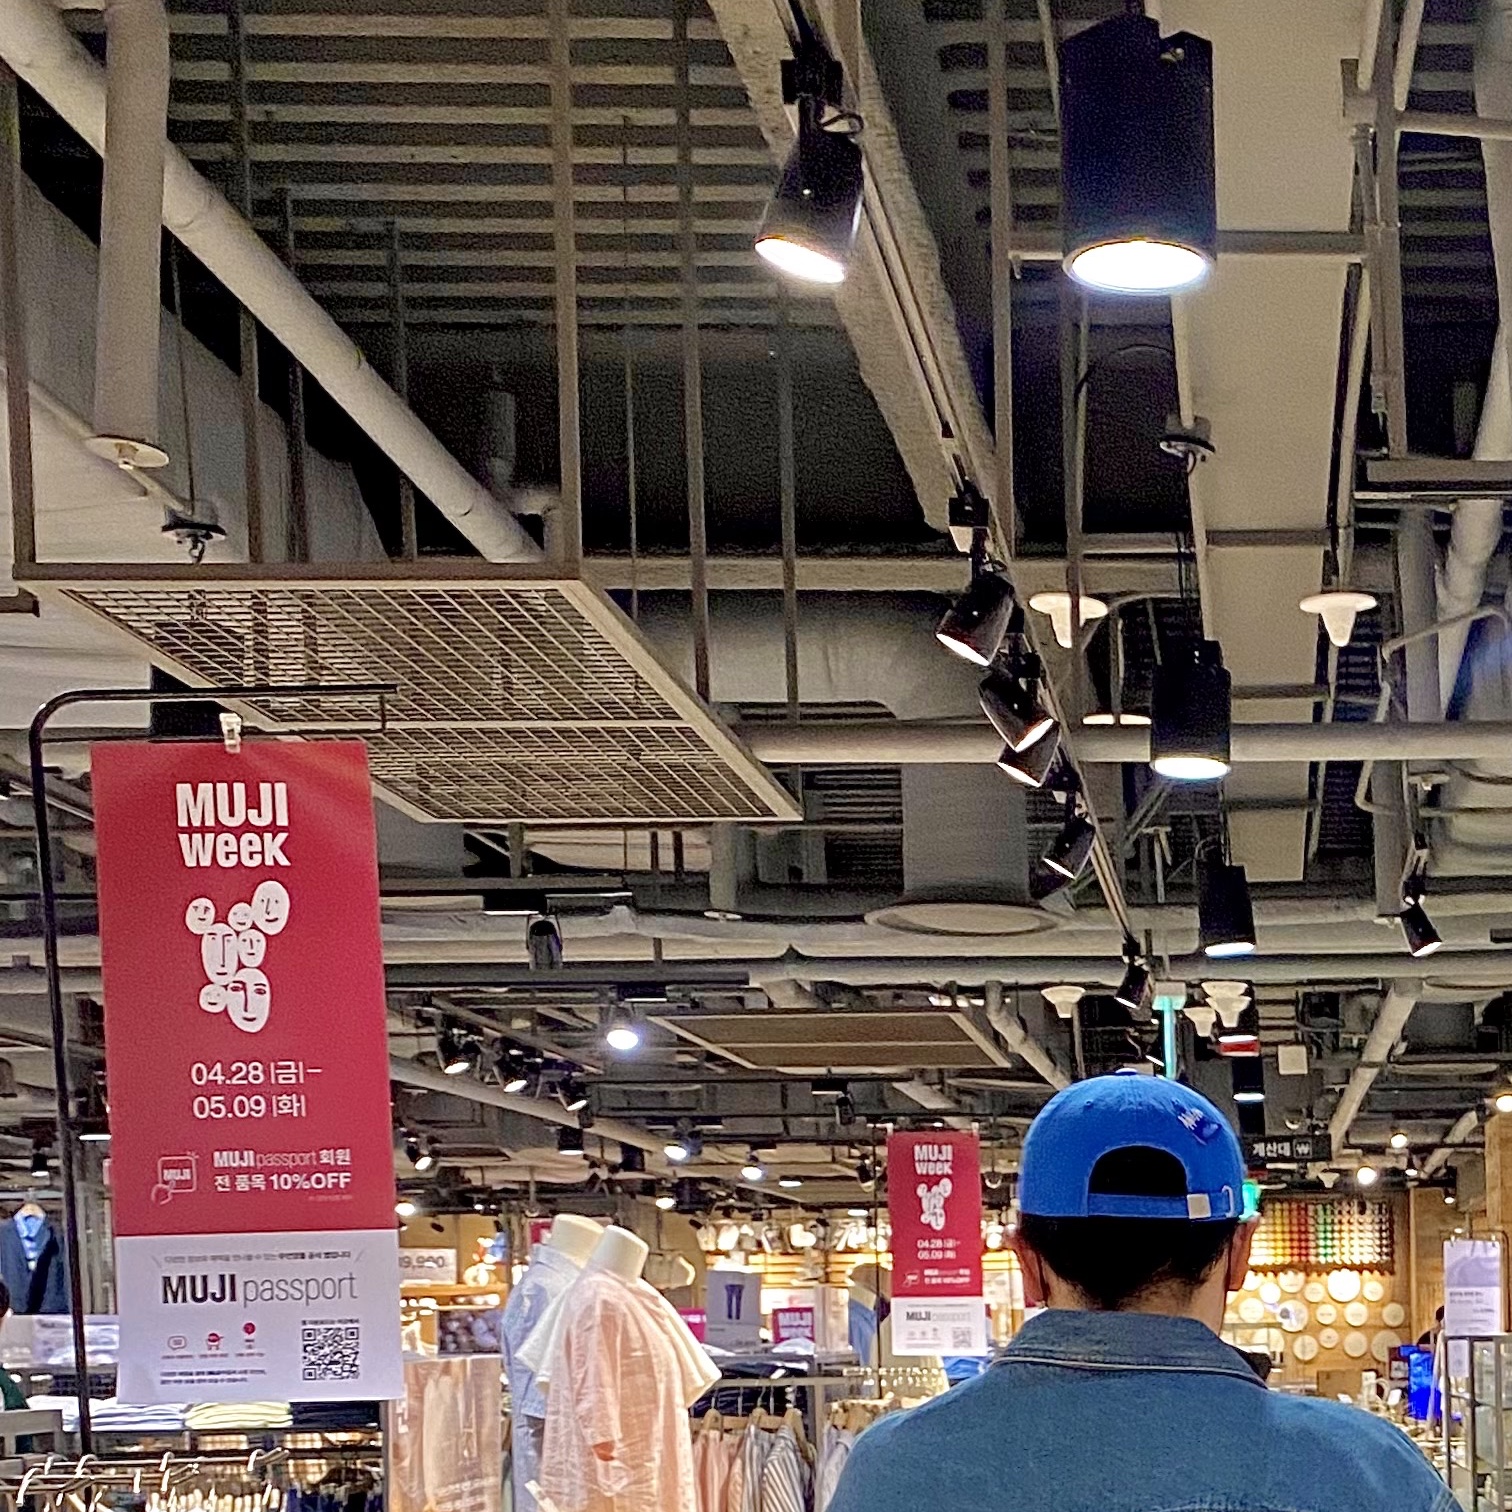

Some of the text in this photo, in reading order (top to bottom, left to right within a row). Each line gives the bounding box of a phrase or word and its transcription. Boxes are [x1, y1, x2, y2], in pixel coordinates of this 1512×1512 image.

[175, 782, 289, 827] MUJI
[178, 832, 291, 867] week
[191, 1062, 264, 1086] 04.28
[193, 1096, 266, 1119] 05.09
[213, 1149, 351, 1169] MUJI passport 회원
[914, 1144, 953, 1161] MUJI
[1253, 1142, 1290, 1157] 계산대
[915, 1161, 953, 1175] week
[215, 1172, 351, 1191] 전 품목 10%OFF
[162, 1272, 358, 1308] MUJI passport
[906, 1311, 931, 1321] MUJI
